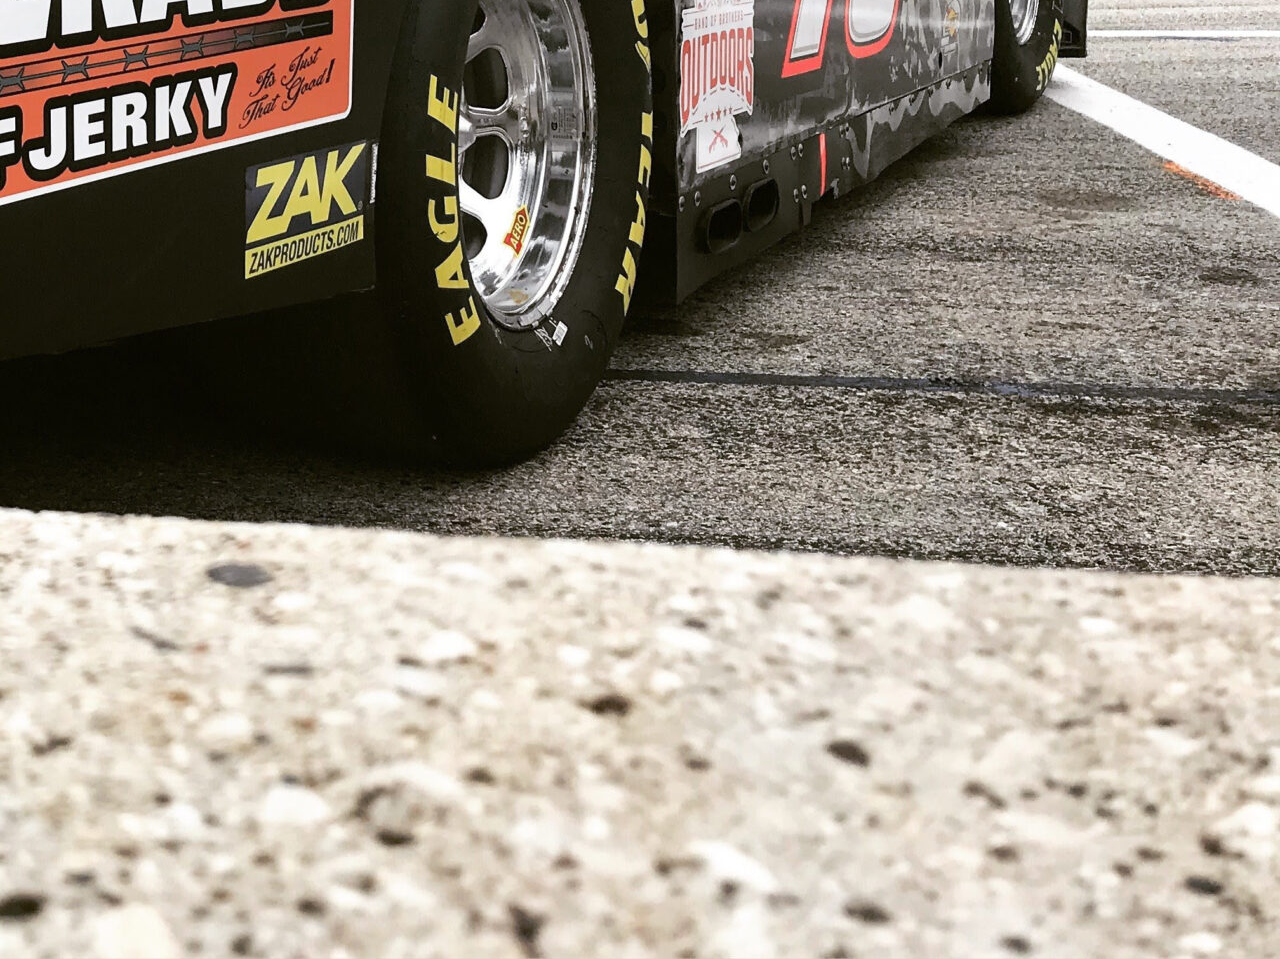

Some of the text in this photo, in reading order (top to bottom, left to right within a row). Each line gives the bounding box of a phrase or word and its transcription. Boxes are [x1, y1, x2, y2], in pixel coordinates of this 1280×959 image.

[29, 72, 235, 167] JERKY
[239, 93, 279, 130] That
[681, 26, 754, 127] OUTDOORS
[246, 142, 367, 245] ZAK
[425, 73, 481, 345] EAGLE
[509, 213, 528, 250] AERO
[249, 221, 359, 275] ZAKPRODUCTS.COM
